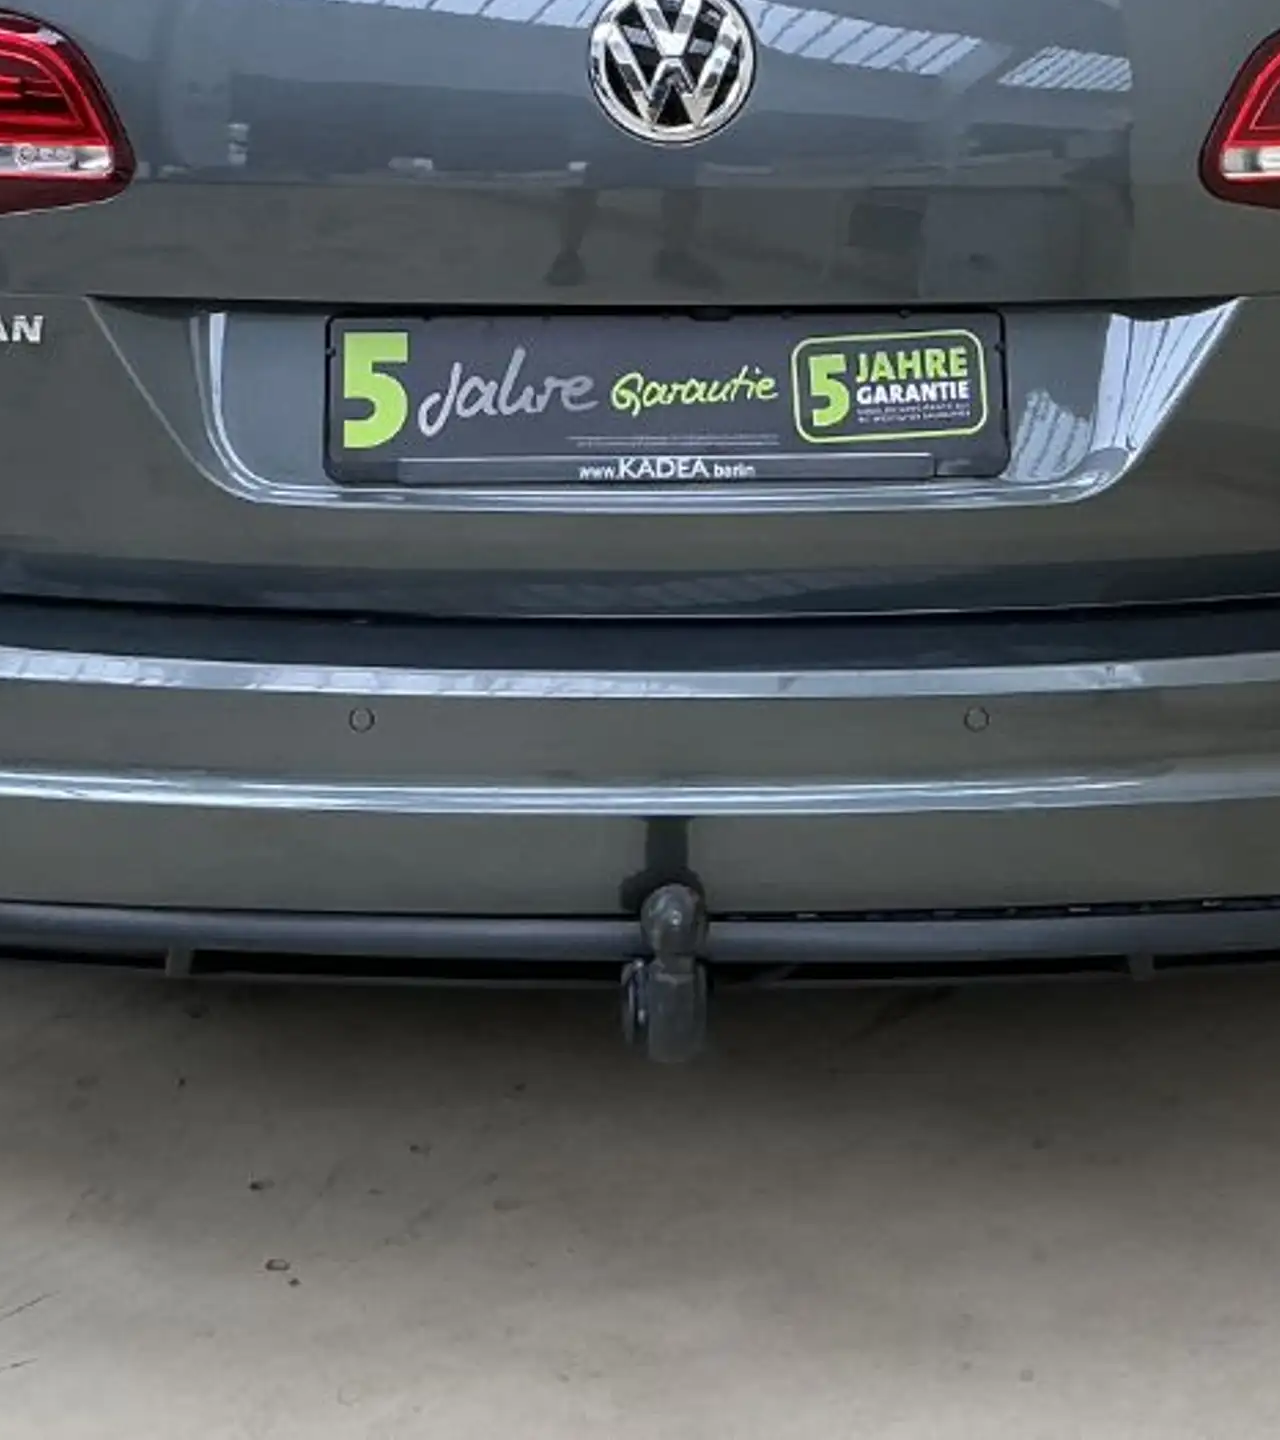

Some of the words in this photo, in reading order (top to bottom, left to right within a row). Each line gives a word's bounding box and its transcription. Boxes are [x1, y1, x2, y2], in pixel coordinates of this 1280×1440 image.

[342, 331, 409, 449] 5
[417, 345, 599, 437] Jahre
[610, 364, 780, 418] Garantie
[808, 353, 850, 427] 5
[855, 346, 969, 384] JAHRE
[855, 380, 970, 405] GARANTIE
